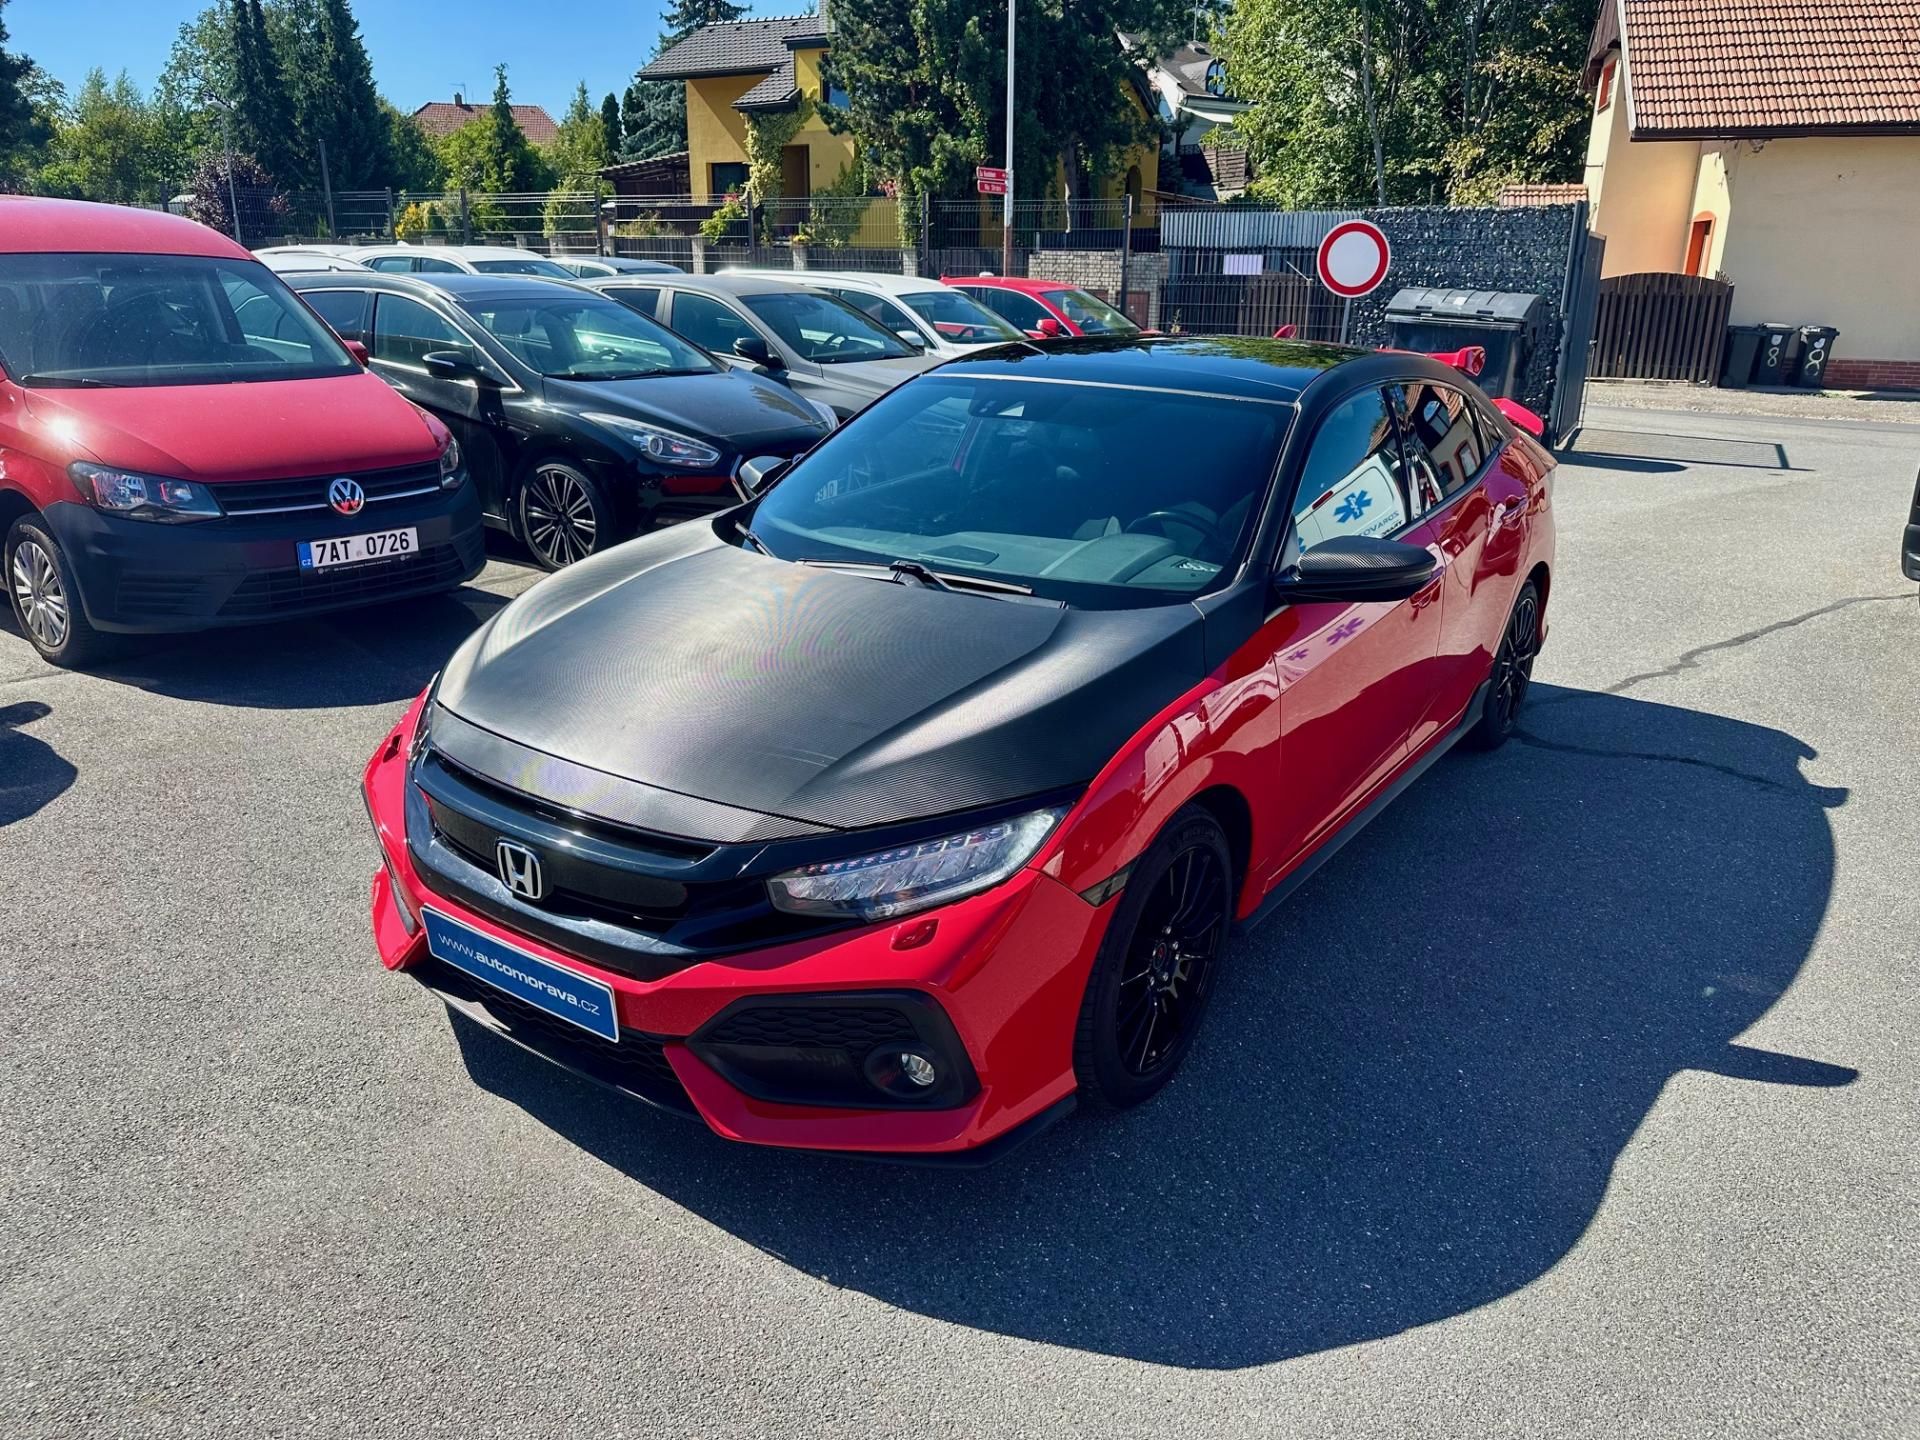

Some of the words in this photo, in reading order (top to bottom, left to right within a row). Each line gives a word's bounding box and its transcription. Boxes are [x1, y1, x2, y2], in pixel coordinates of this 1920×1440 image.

[302, 558, 312, 566] CZ
[316, 540, 351, 564] 7AT
[366, 532, 409, 556] 0726
[438, 932, 600, 1016] www.automorava.cz
